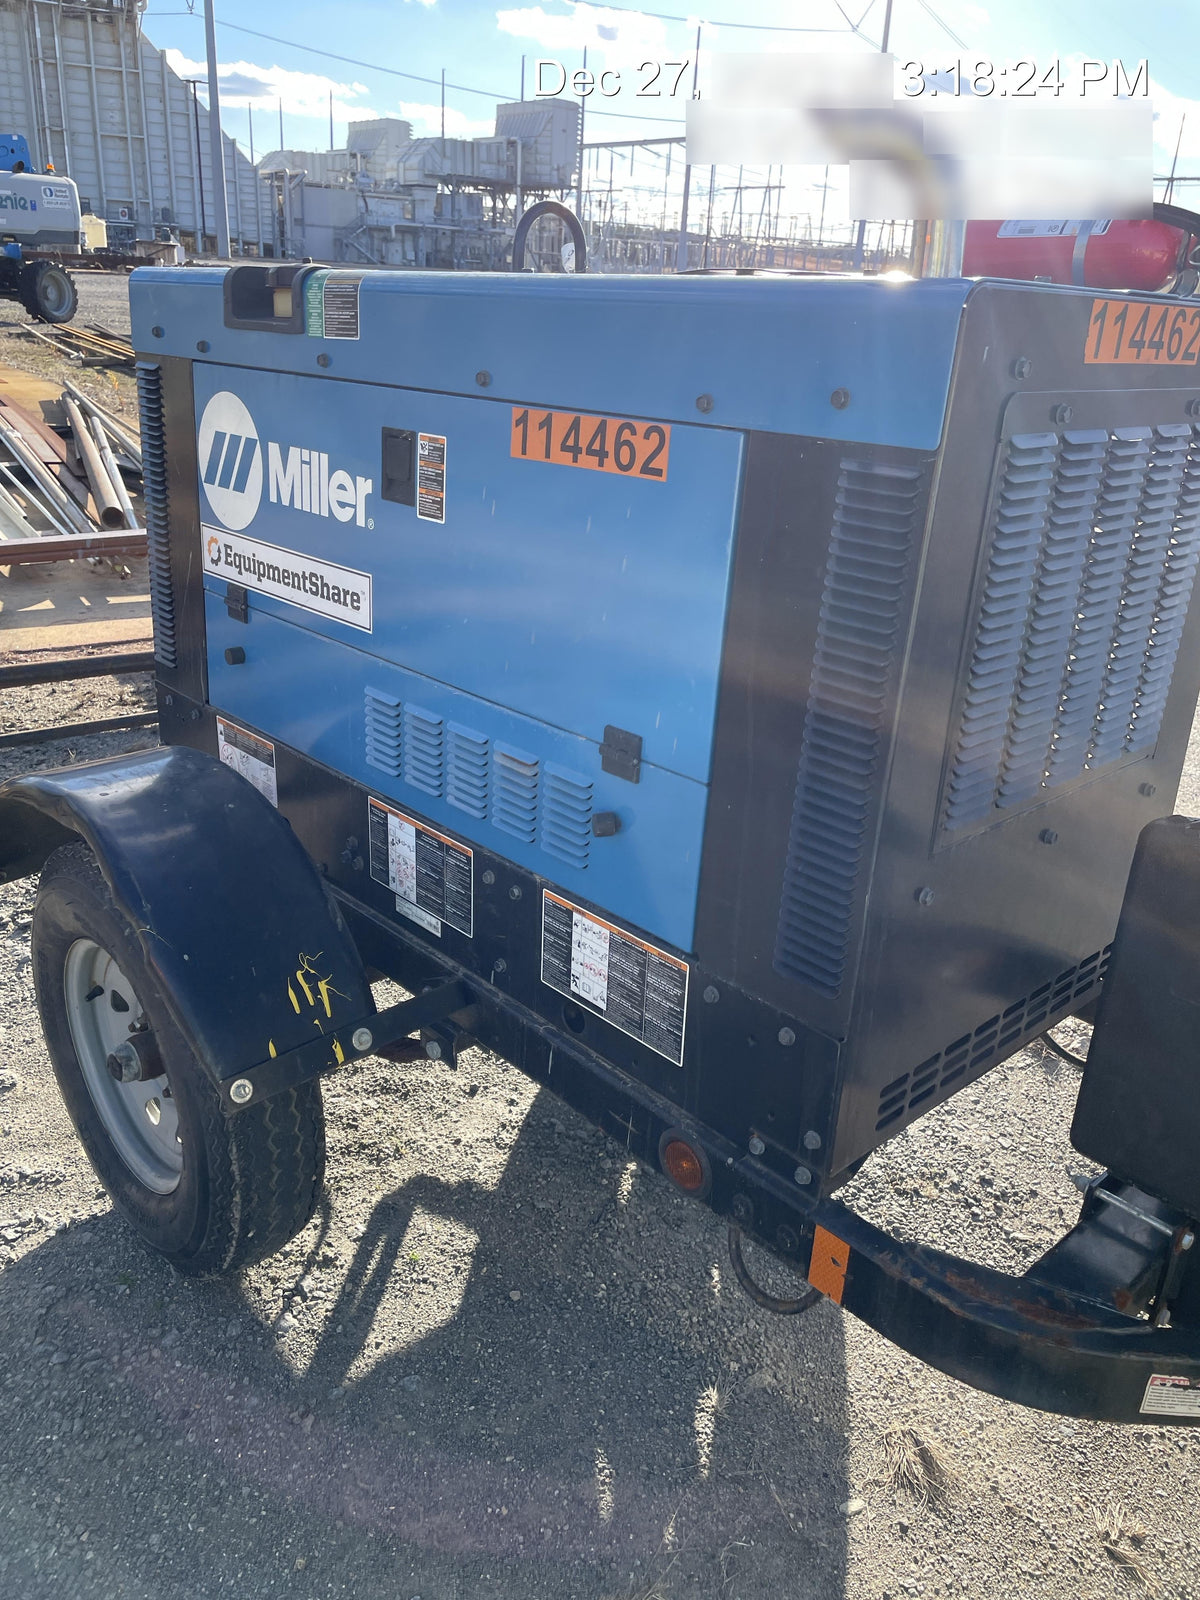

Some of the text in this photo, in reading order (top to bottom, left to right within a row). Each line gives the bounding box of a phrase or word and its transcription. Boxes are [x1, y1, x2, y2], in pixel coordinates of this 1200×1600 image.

[1091, 301, 1200, 362] 114462
[514, 409, 667, 478] 114462
[267, 441, 373, 528] Miller
[223, 542, 362, 612] EquipmentShare
